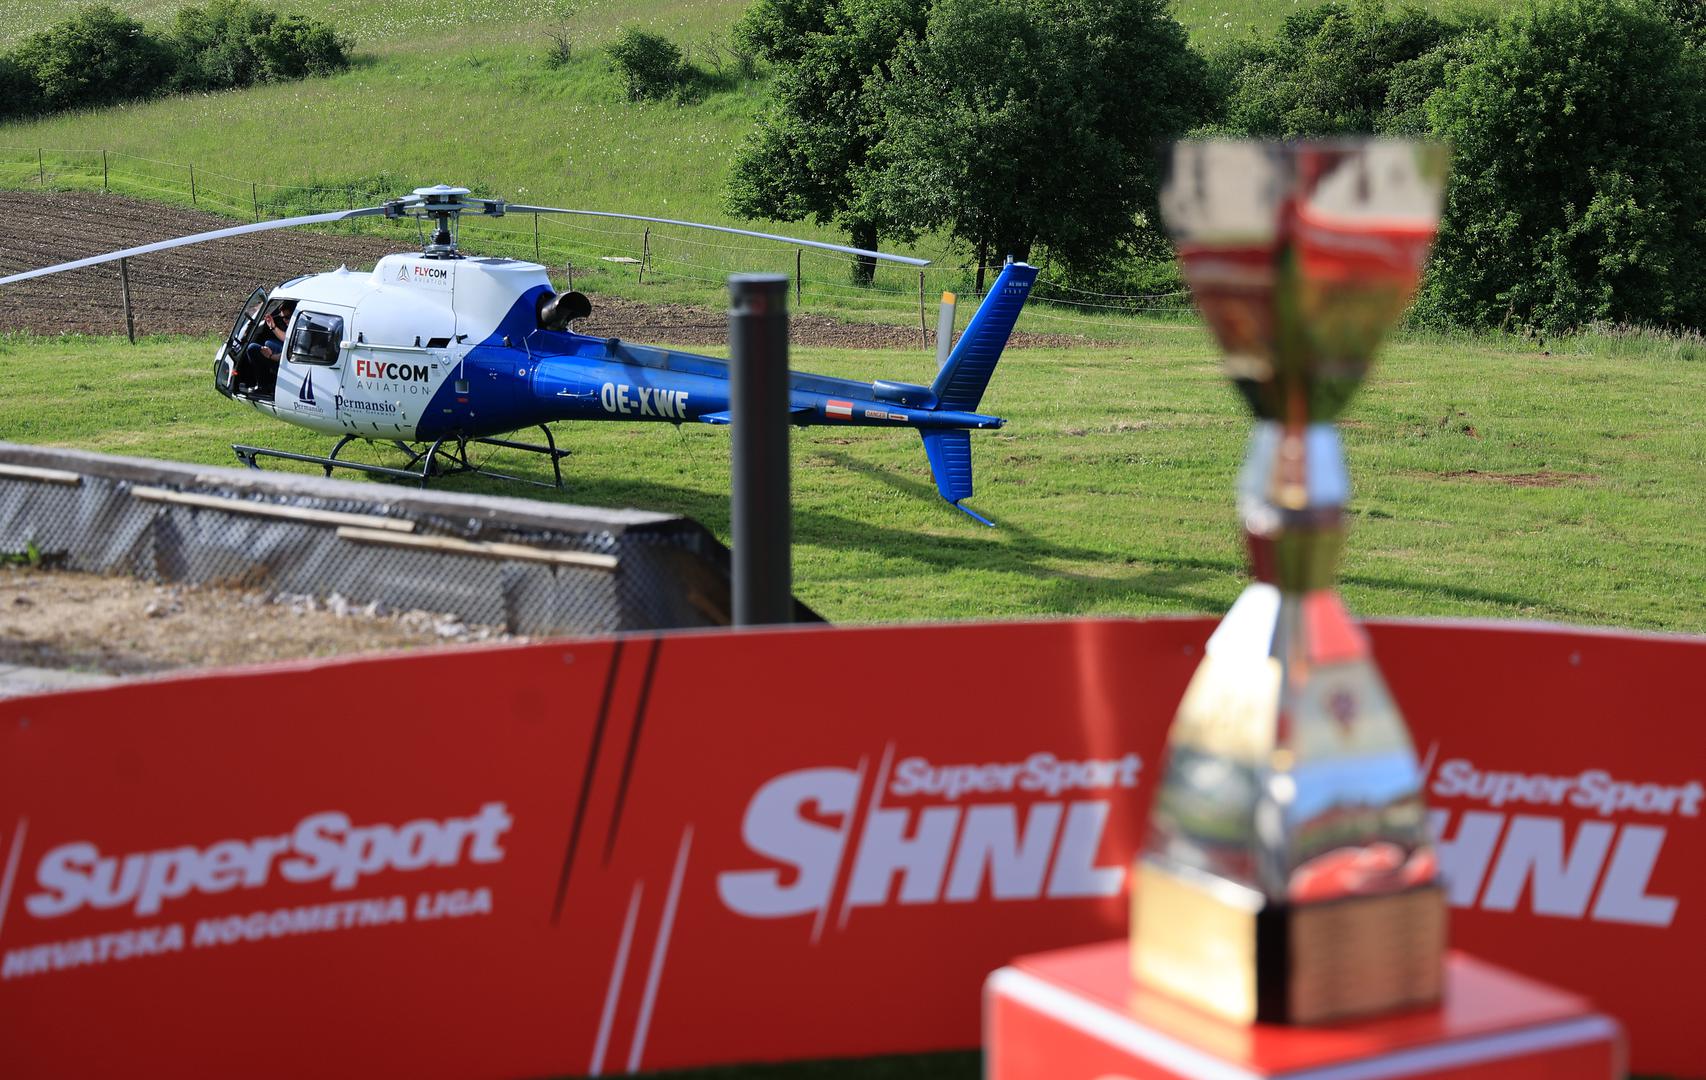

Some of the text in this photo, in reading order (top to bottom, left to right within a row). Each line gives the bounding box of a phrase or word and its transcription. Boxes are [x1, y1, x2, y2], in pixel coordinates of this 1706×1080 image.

[414, 266, 447, 279] FLYCOM
[414, 277, 447, 286] AVIATION
[356, 359, 429, 383] FLYCOM
[356, 380, 429, 395] AVIATION
[601, 382, 689, 419] OE-XWF
[891, 752, 1141, 800] SuperSport
[1432, 758, 1704, 817] SuperSport
[25, 801, 512, 918] SuperSport
[1425, 807, 1679, 928] HNL
[1, 887, 493, 980] HRVATSKA NOGOMETNA LIGA
